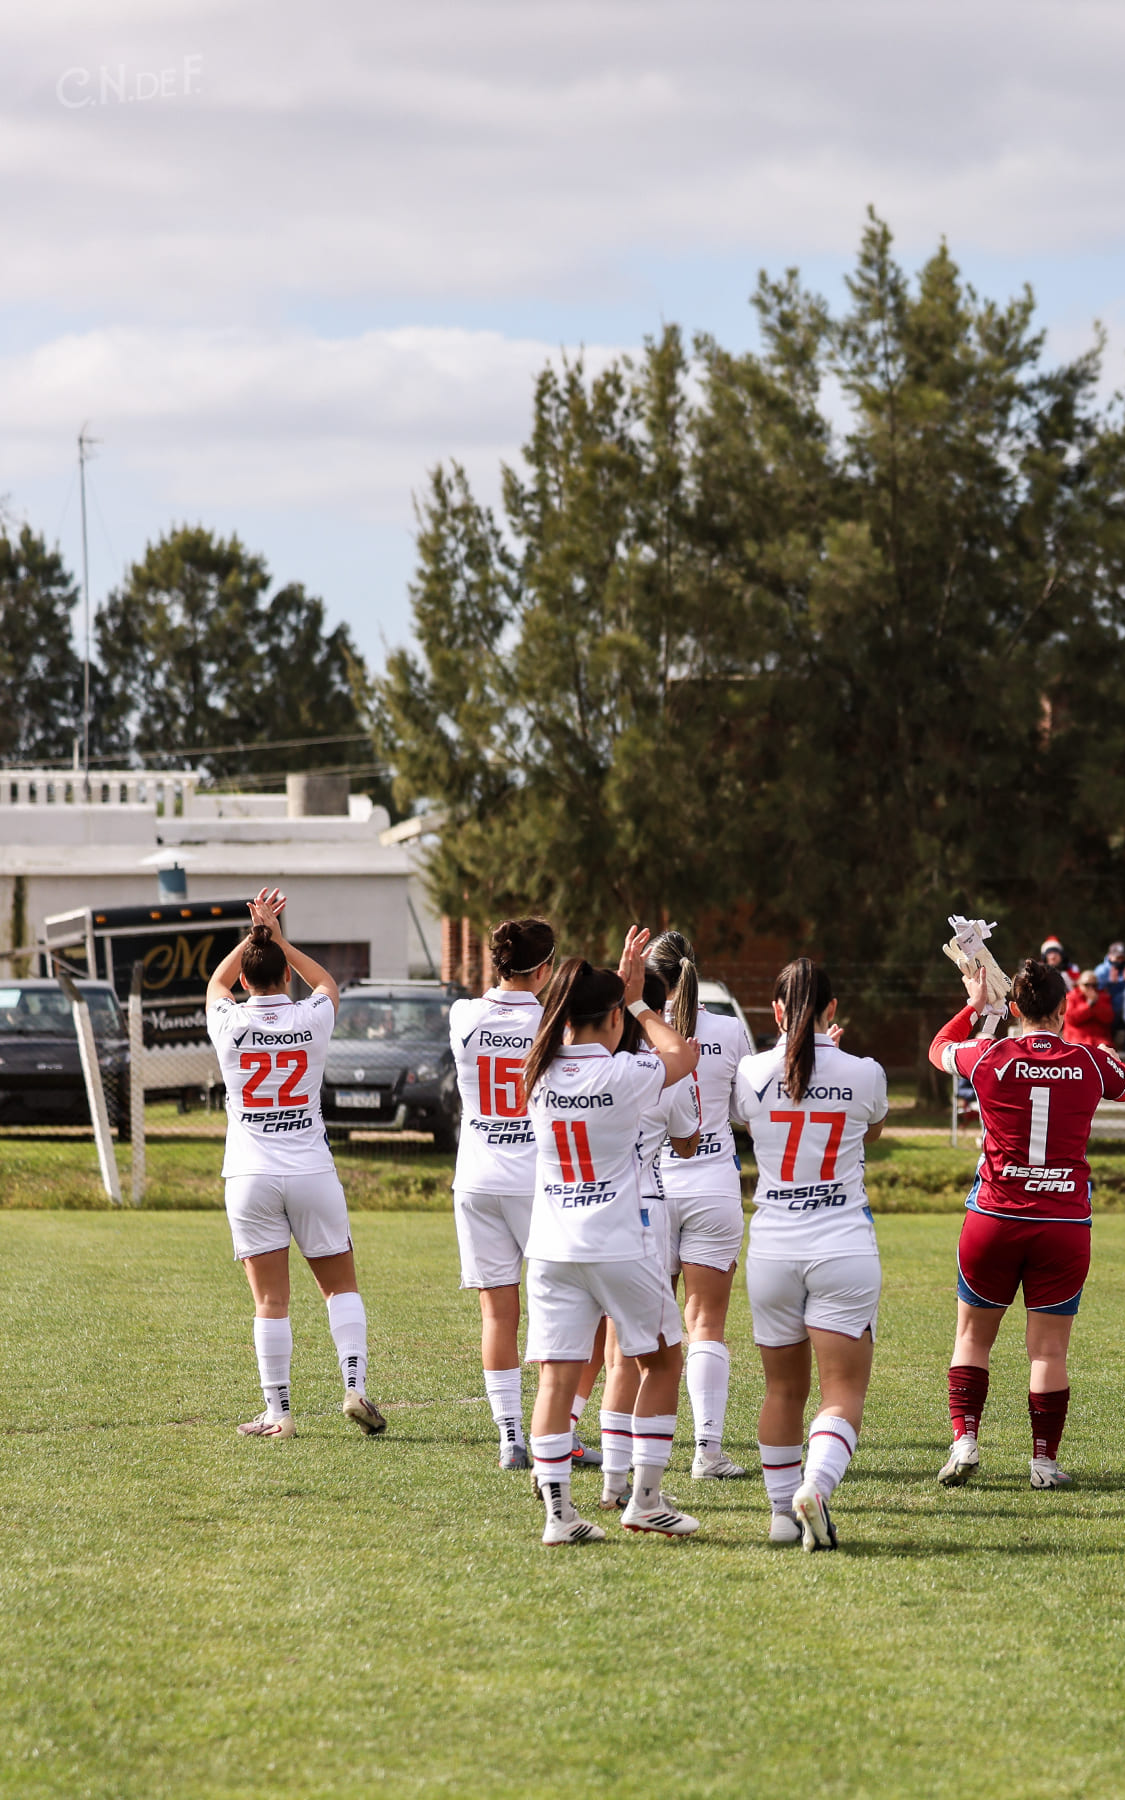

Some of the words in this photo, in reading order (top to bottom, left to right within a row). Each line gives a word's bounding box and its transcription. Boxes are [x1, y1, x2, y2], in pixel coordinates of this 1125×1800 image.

[252, 1030, 313, 1045] Rexona
[479, 1031, 533, 1048] Rexon
[240, 1050, 309, 1107] 22
[1015, 1062, 1083, 1080] Rexona
[476, 1055, 529, 1117] 15
[777, 1081, 853, 1101] Rxona
[545, 1091, 614, 1109] Rexona
[241, 1109, 308, 1122] ASSIST
[262, 1118, 313, 1133] CARD
[469, 1119, 532, 1132] ASSIST
[1029, 1086, 1050, 1166] 1
[551, 1120, 596, 1183] 11
[769, 1110, 847, 1182] 77
[1001, 1165, 1074, 1180] ASSIST
[544, 1181, 612, 1195] ASSIST
[766, 1183, 844, 1200] ASSIST
[1024, 1180, 1076, 1193] CARD
[562, 1192, 617, 1209] CARD
[788, 1194, 847, 1211] CARD
